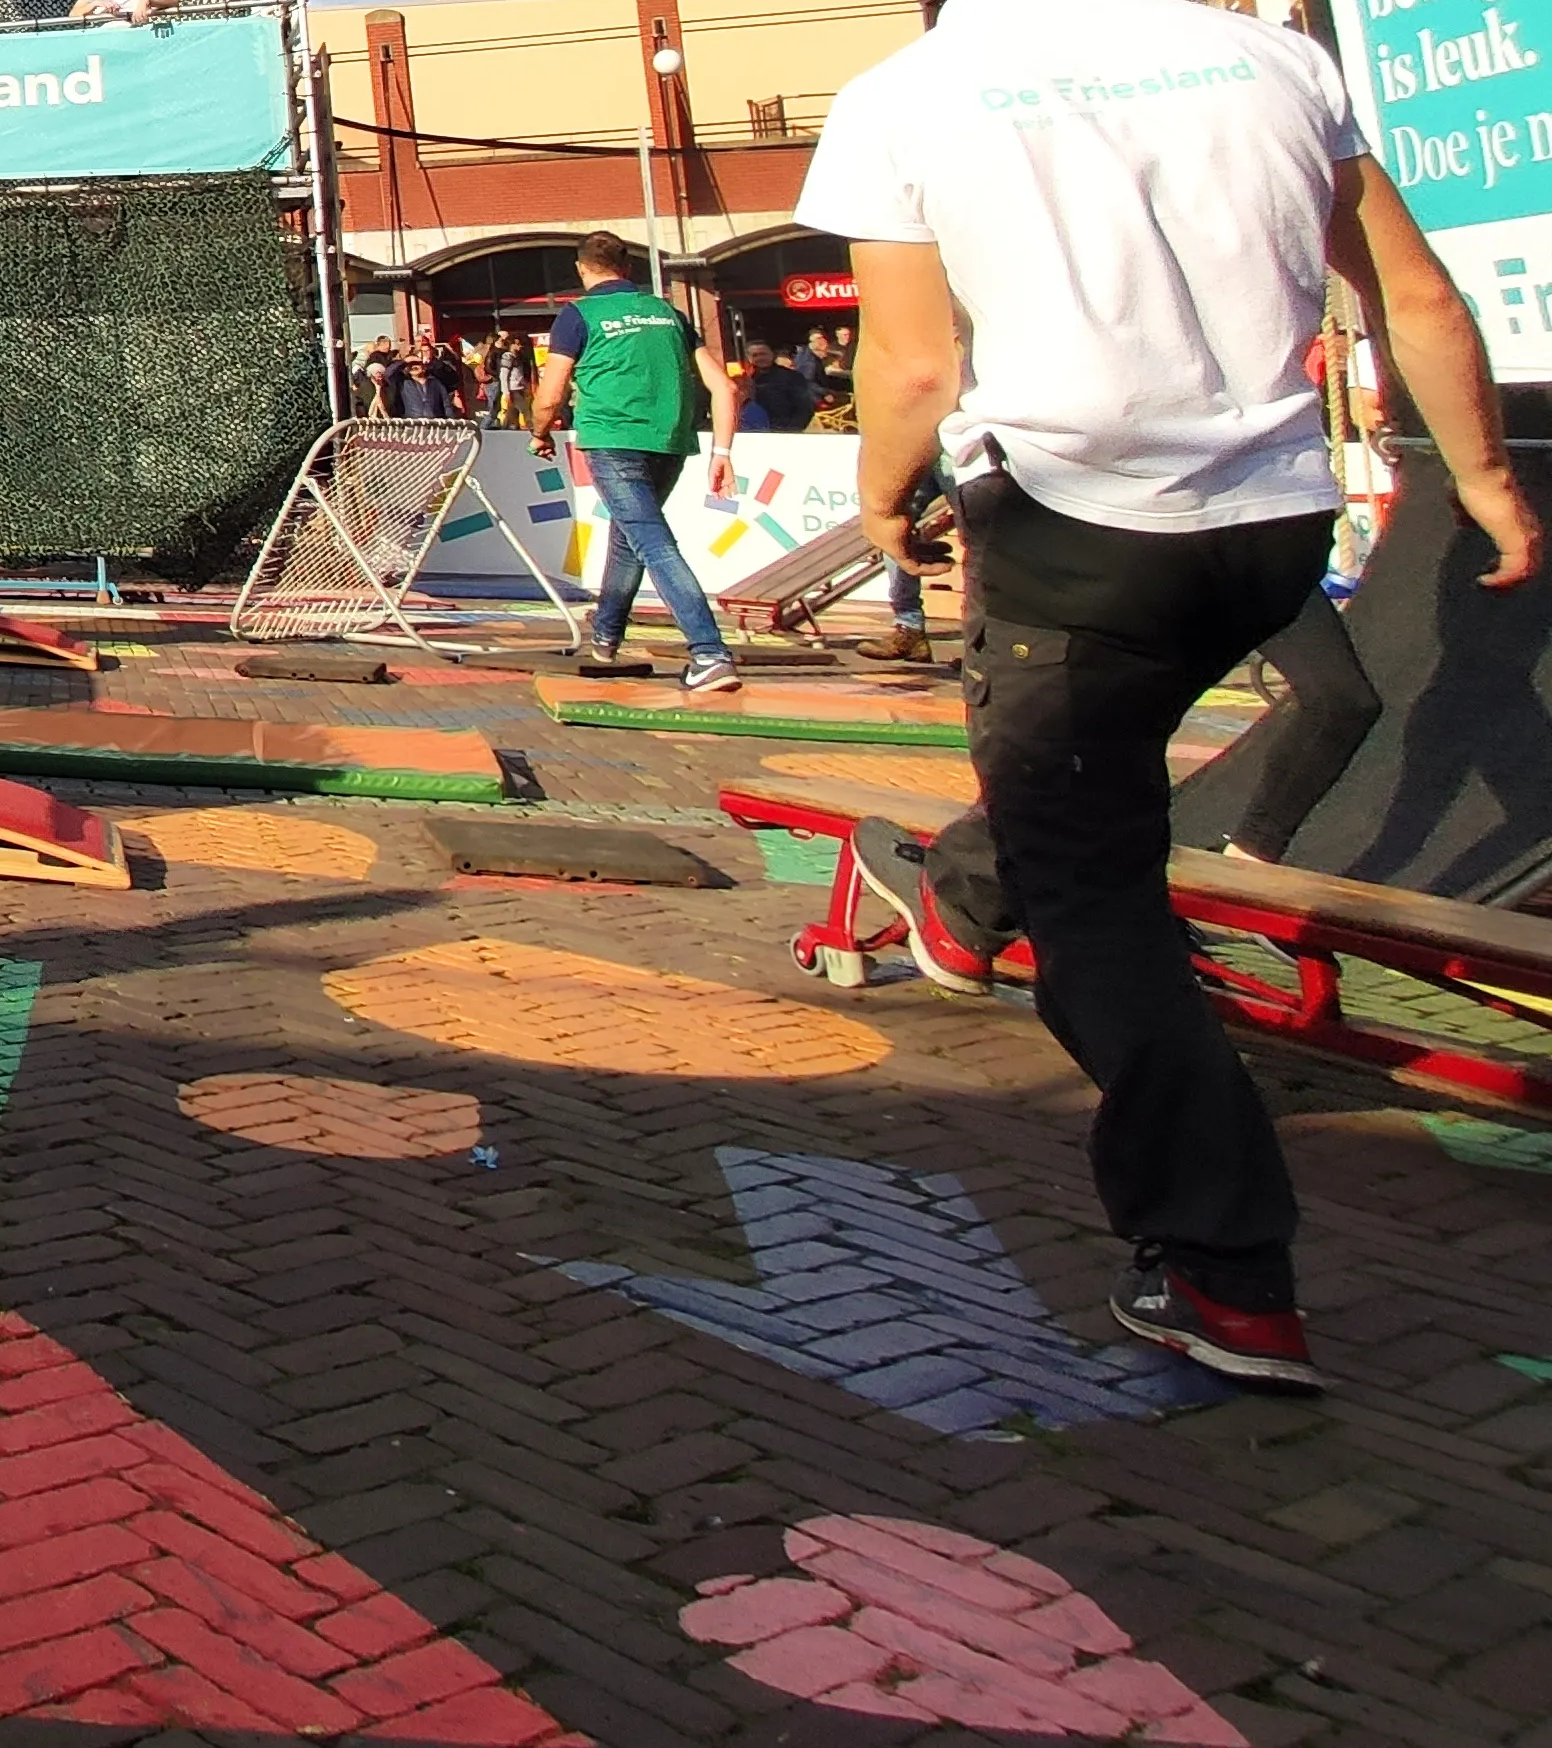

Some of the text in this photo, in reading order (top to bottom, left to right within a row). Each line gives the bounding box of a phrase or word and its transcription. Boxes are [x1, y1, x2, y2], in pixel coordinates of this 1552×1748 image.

[980, 56, 1256, 110] De Friesland
[1378, 7, 1539, 103] is leuk.
[1391, 125, 1470, 188] Doe
[1475, 108, 1518, 190] je
